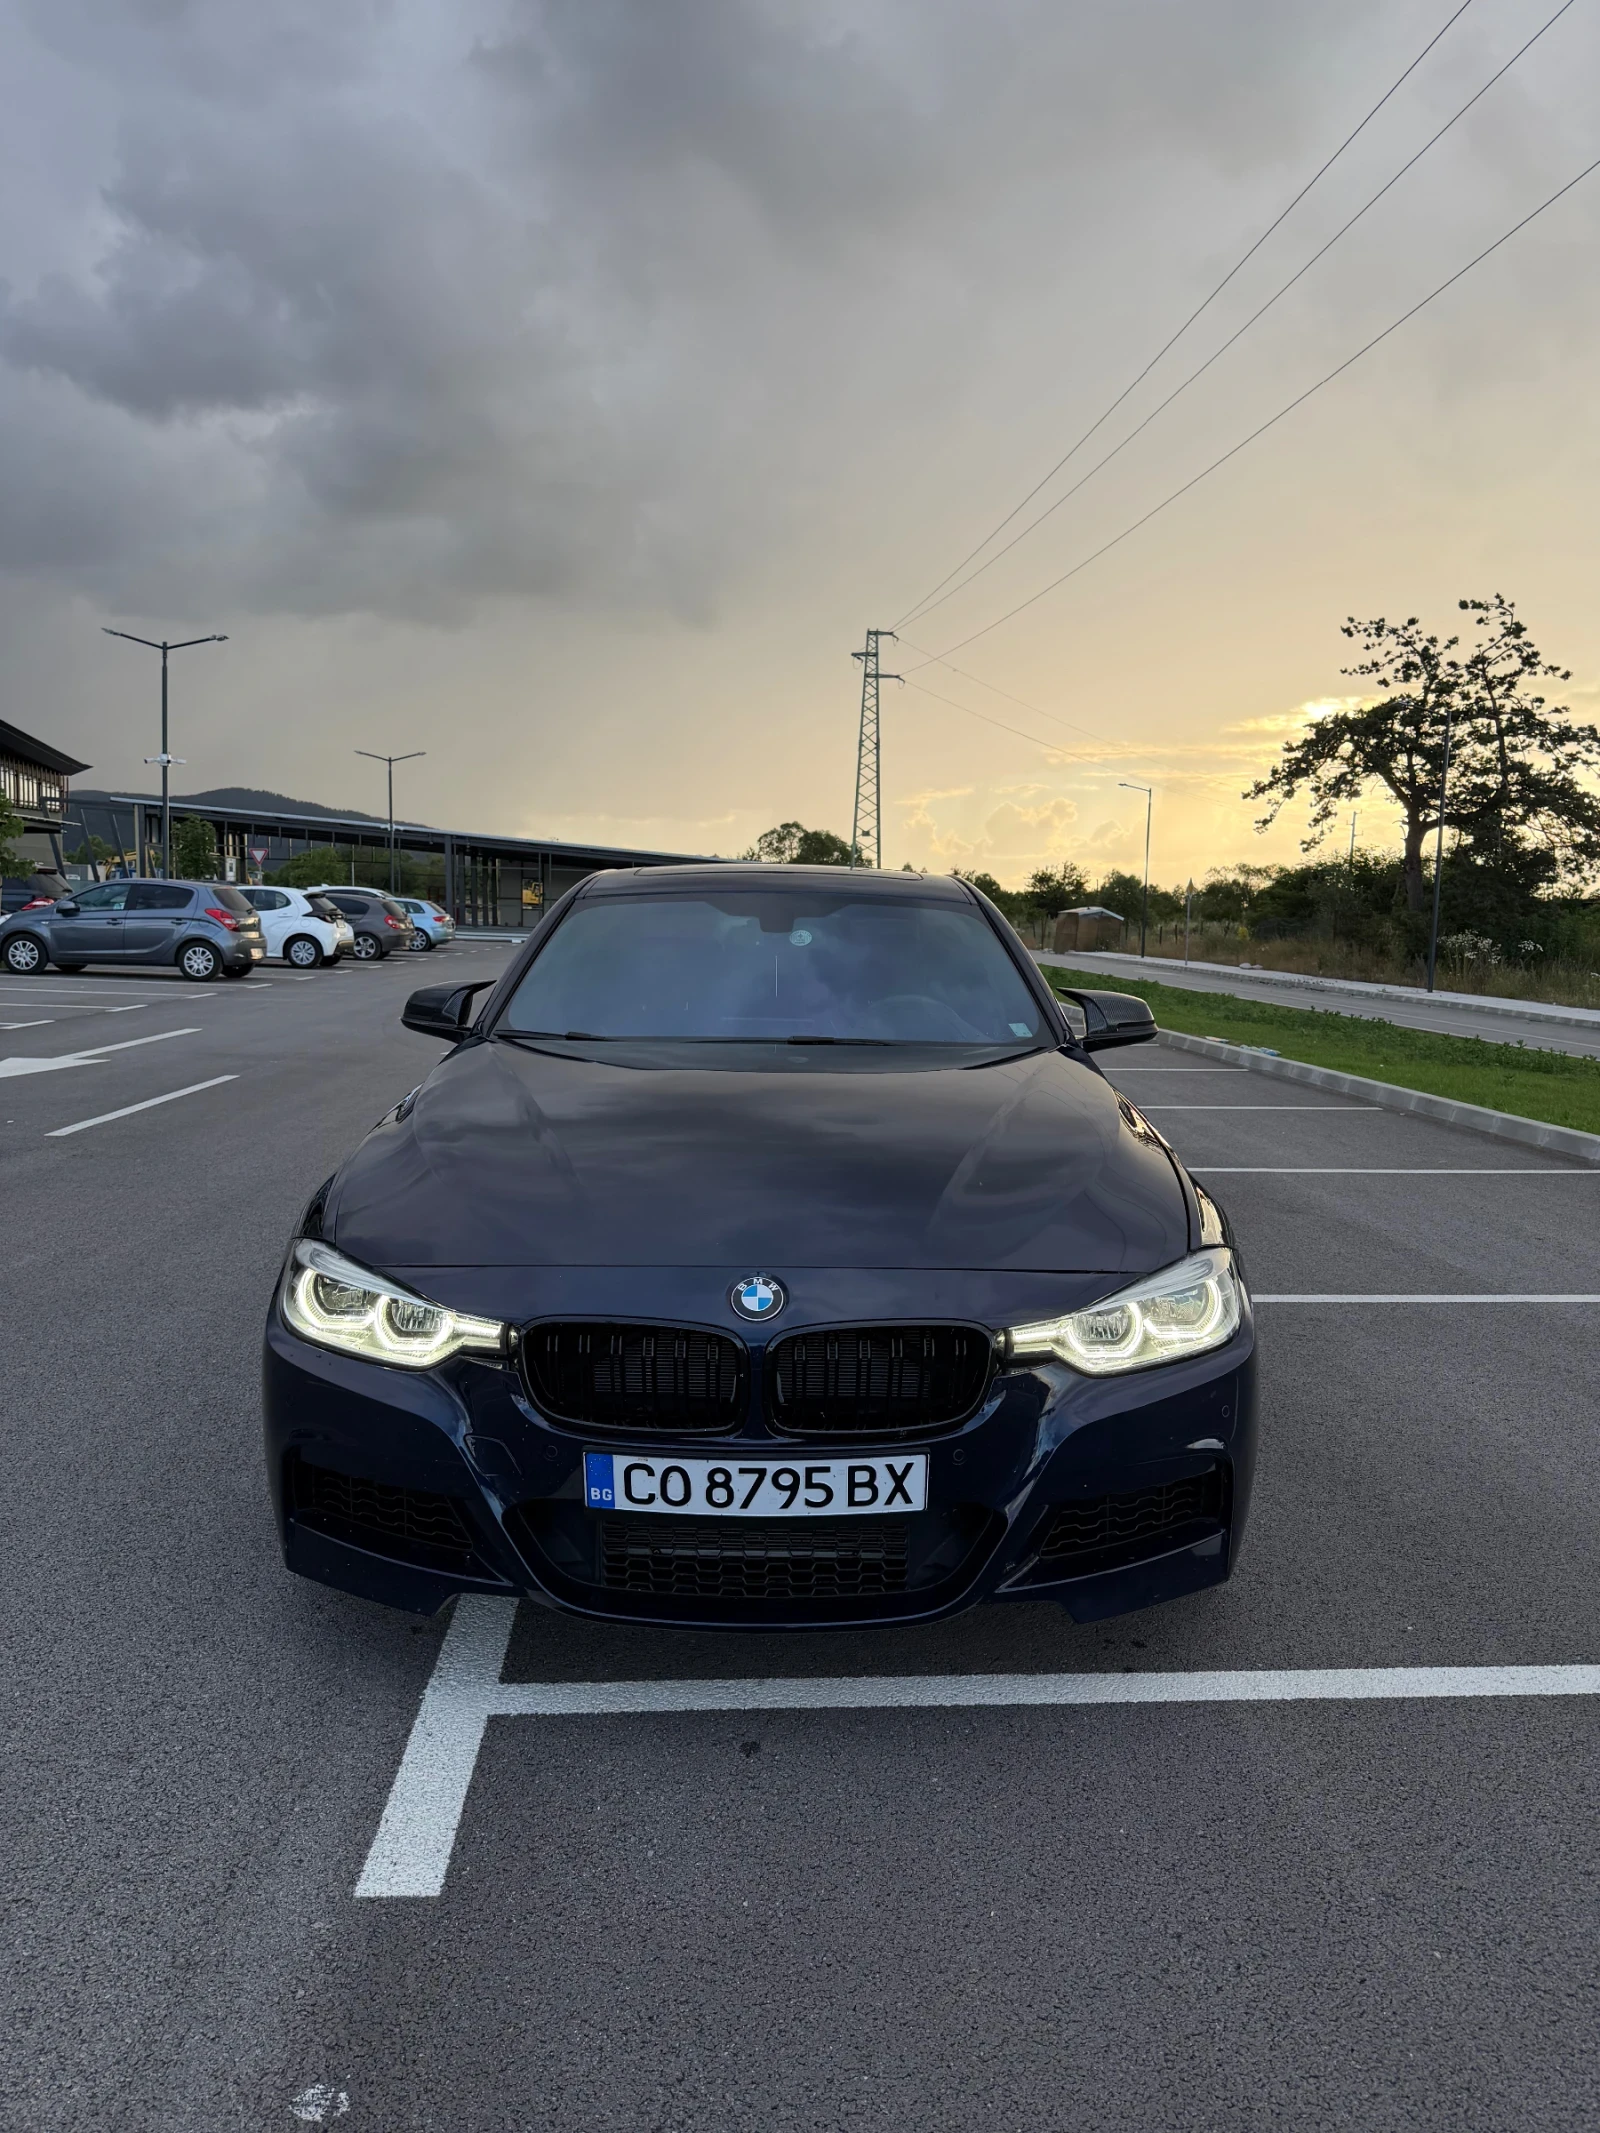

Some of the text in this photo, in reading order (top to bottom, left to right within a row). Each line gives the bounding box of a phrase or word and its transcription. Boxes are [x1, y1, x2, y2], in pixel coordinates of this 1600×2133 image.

[737, 1278, 779, 1291] BMW
[623, 1462, 914, 1509] CO 8795 BX
[590, 1487, 613, 1501] BG
